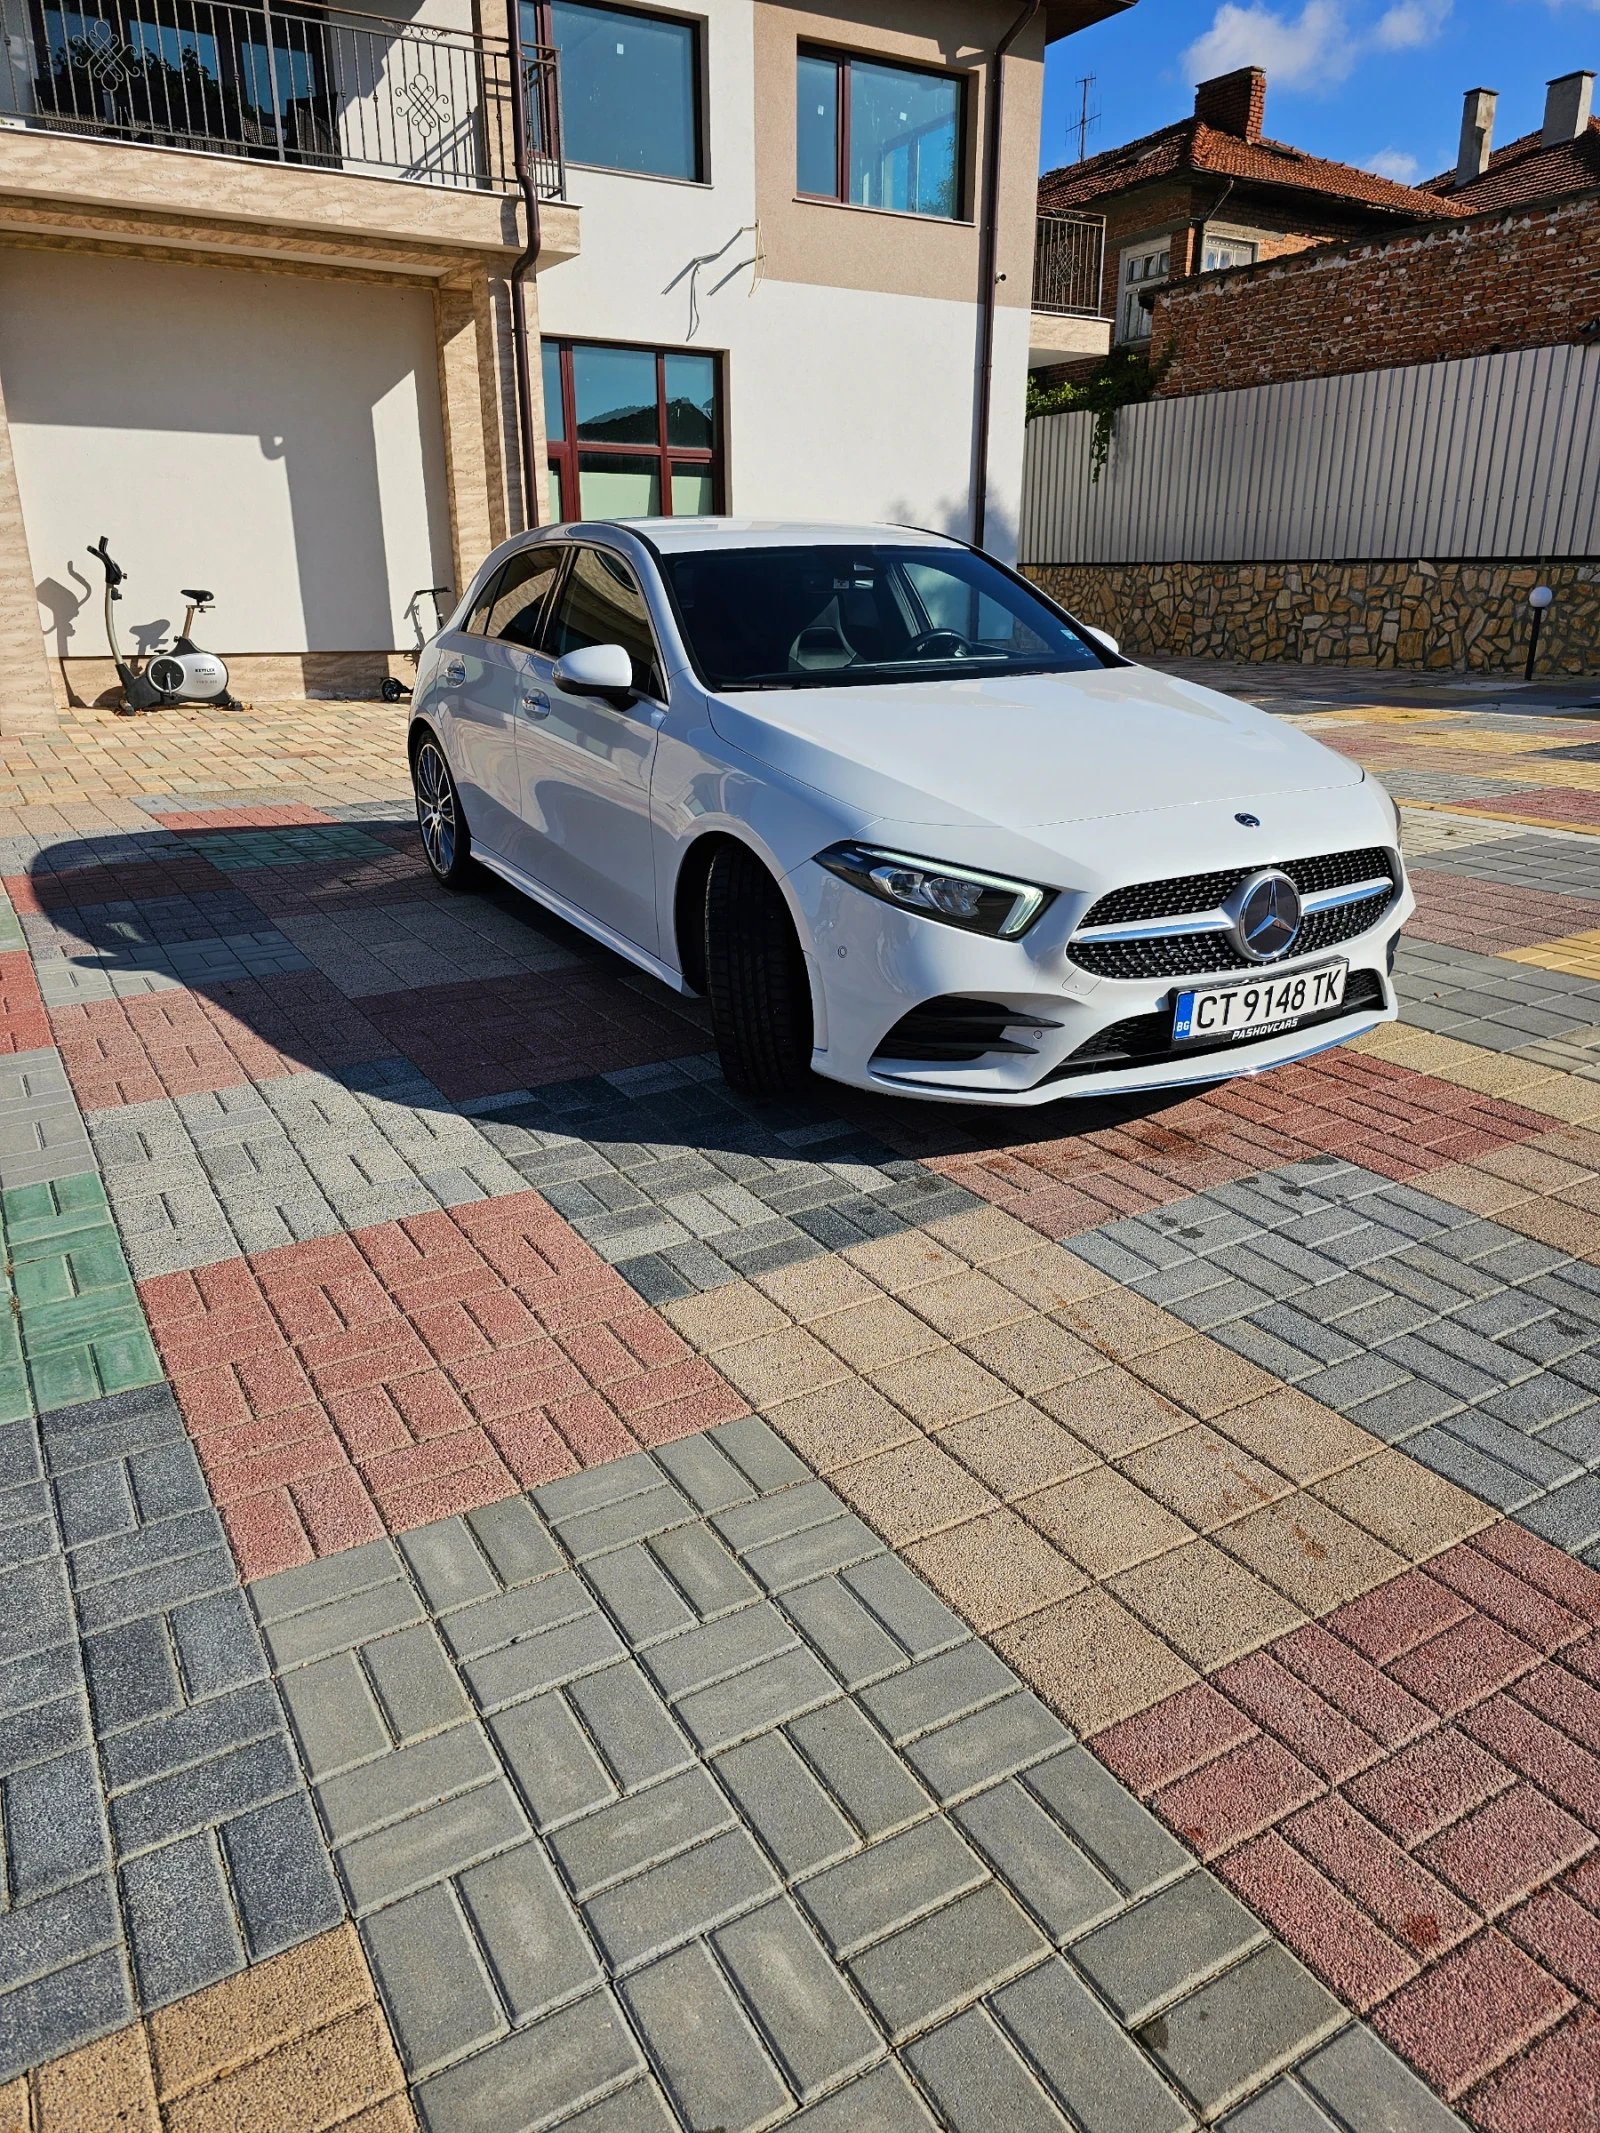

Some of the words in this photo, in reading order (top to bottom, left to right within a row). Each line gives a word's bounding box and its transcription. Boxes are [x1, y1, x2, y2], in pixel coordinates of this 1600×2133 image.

[1197, 992, 1238, 1029] CT
[1244, 979, 1307, 1022] 9148
[1313, 969, 1342, 1006] TK
[1176, 1020, 1191, 1032] BG
[1231, 1018, 1299, 1041] PASHOVCARS
